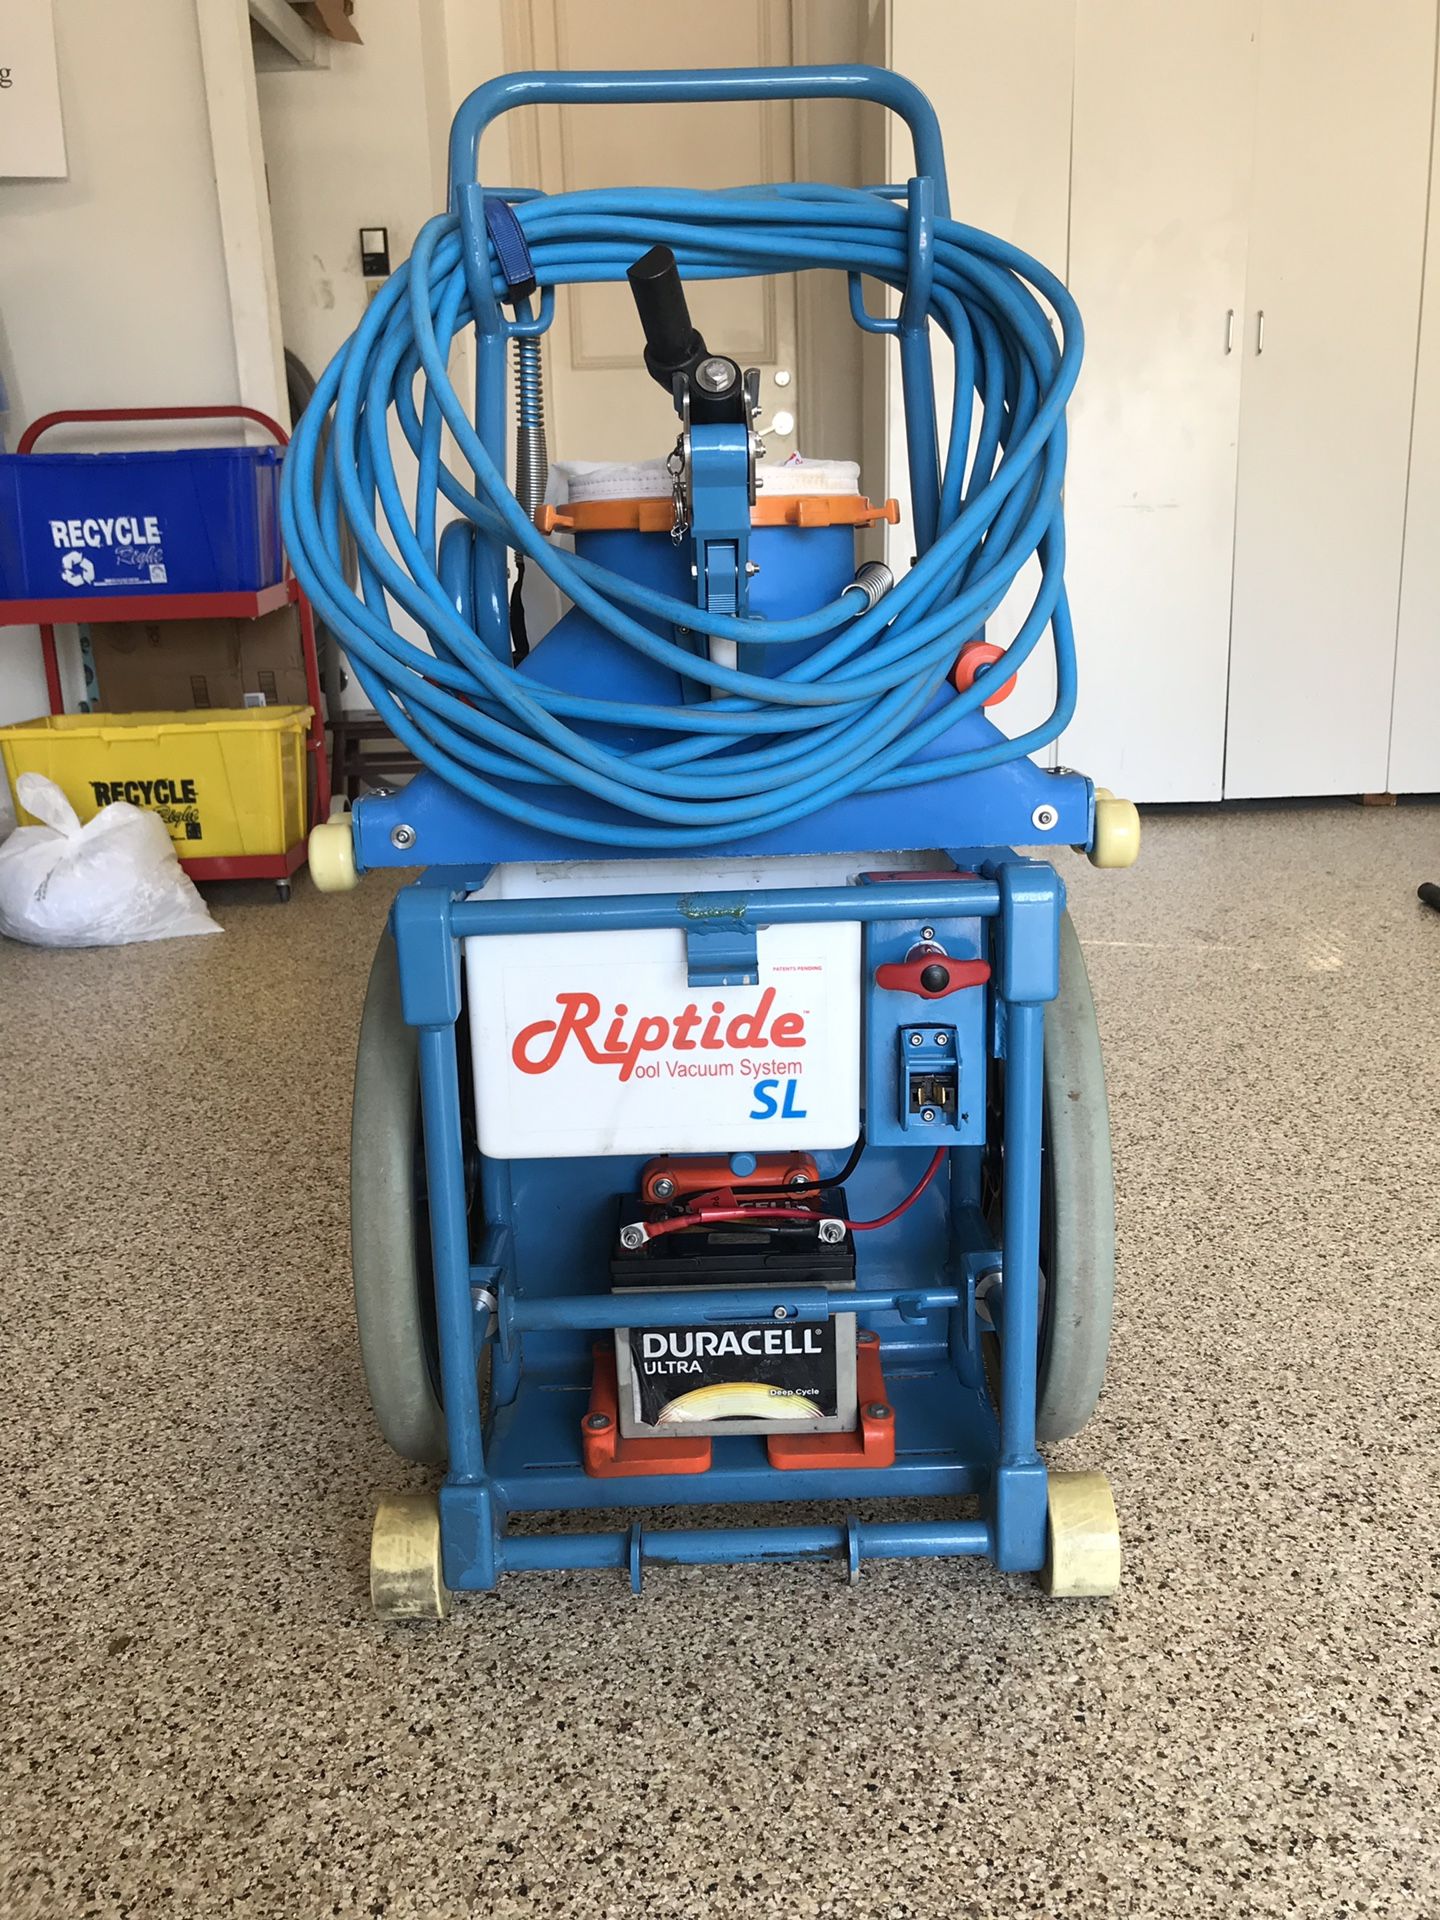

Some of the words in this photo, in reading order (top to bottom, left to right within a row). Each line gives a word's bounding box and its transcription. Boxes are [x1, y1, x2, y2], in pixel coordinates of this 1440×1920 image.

[50, 516, 162, 548] RECYCLE
[115, 545, 164, 570] Right
[90, 778, 198, 807] RECYCLE
[511, 986, 807, 1082] Riptide
[665, 1059, 734, 1078] Vacuum
[739, 1058, 803, 1080] System
[749, 1079, 808, 1120] SL
[642, 1328, 823, 1358] DURACELL
[643, 1360, 703, 1375] ULTRA
[769, 1388, 794, 1397] Deep
[795, 1387, 820, 1397] Cycle
